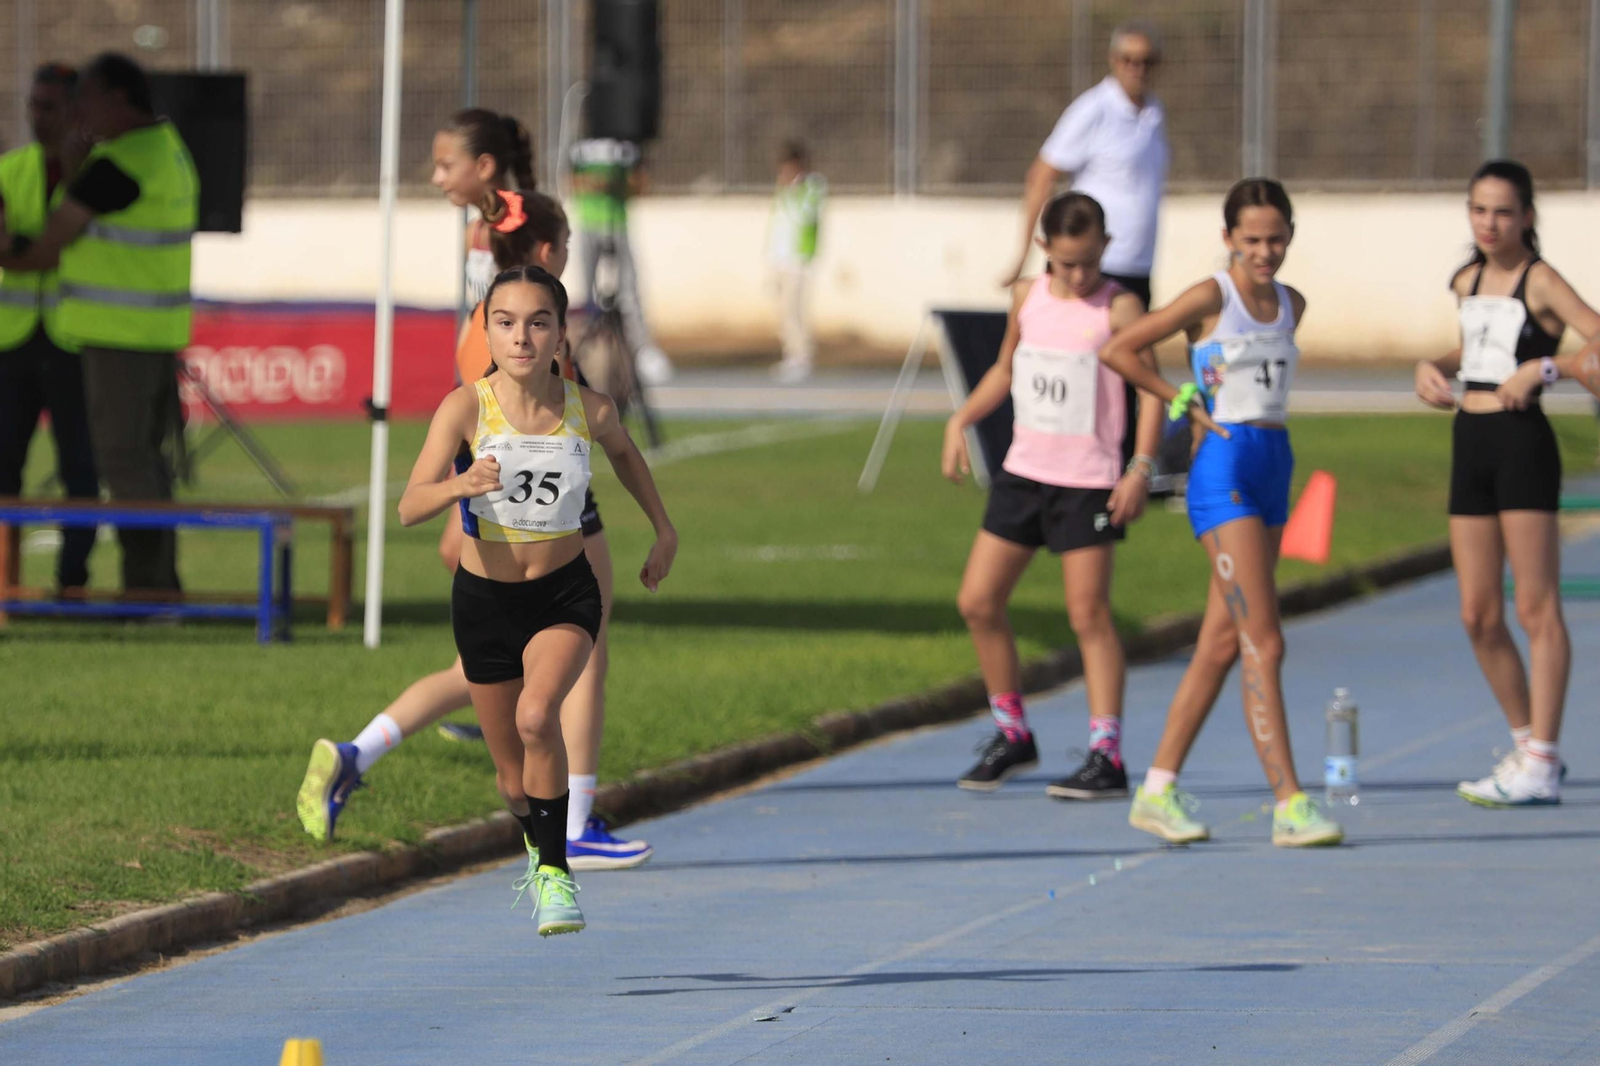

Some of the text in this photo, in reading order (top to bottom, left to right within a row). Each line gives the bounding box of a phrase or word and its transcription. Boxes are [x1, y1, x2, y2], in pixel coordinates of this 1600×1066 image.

[1031, 371, 1068, 407] 90
[1254, 356, 1288, 391] 47
[508, 469, 562, 506] 35
